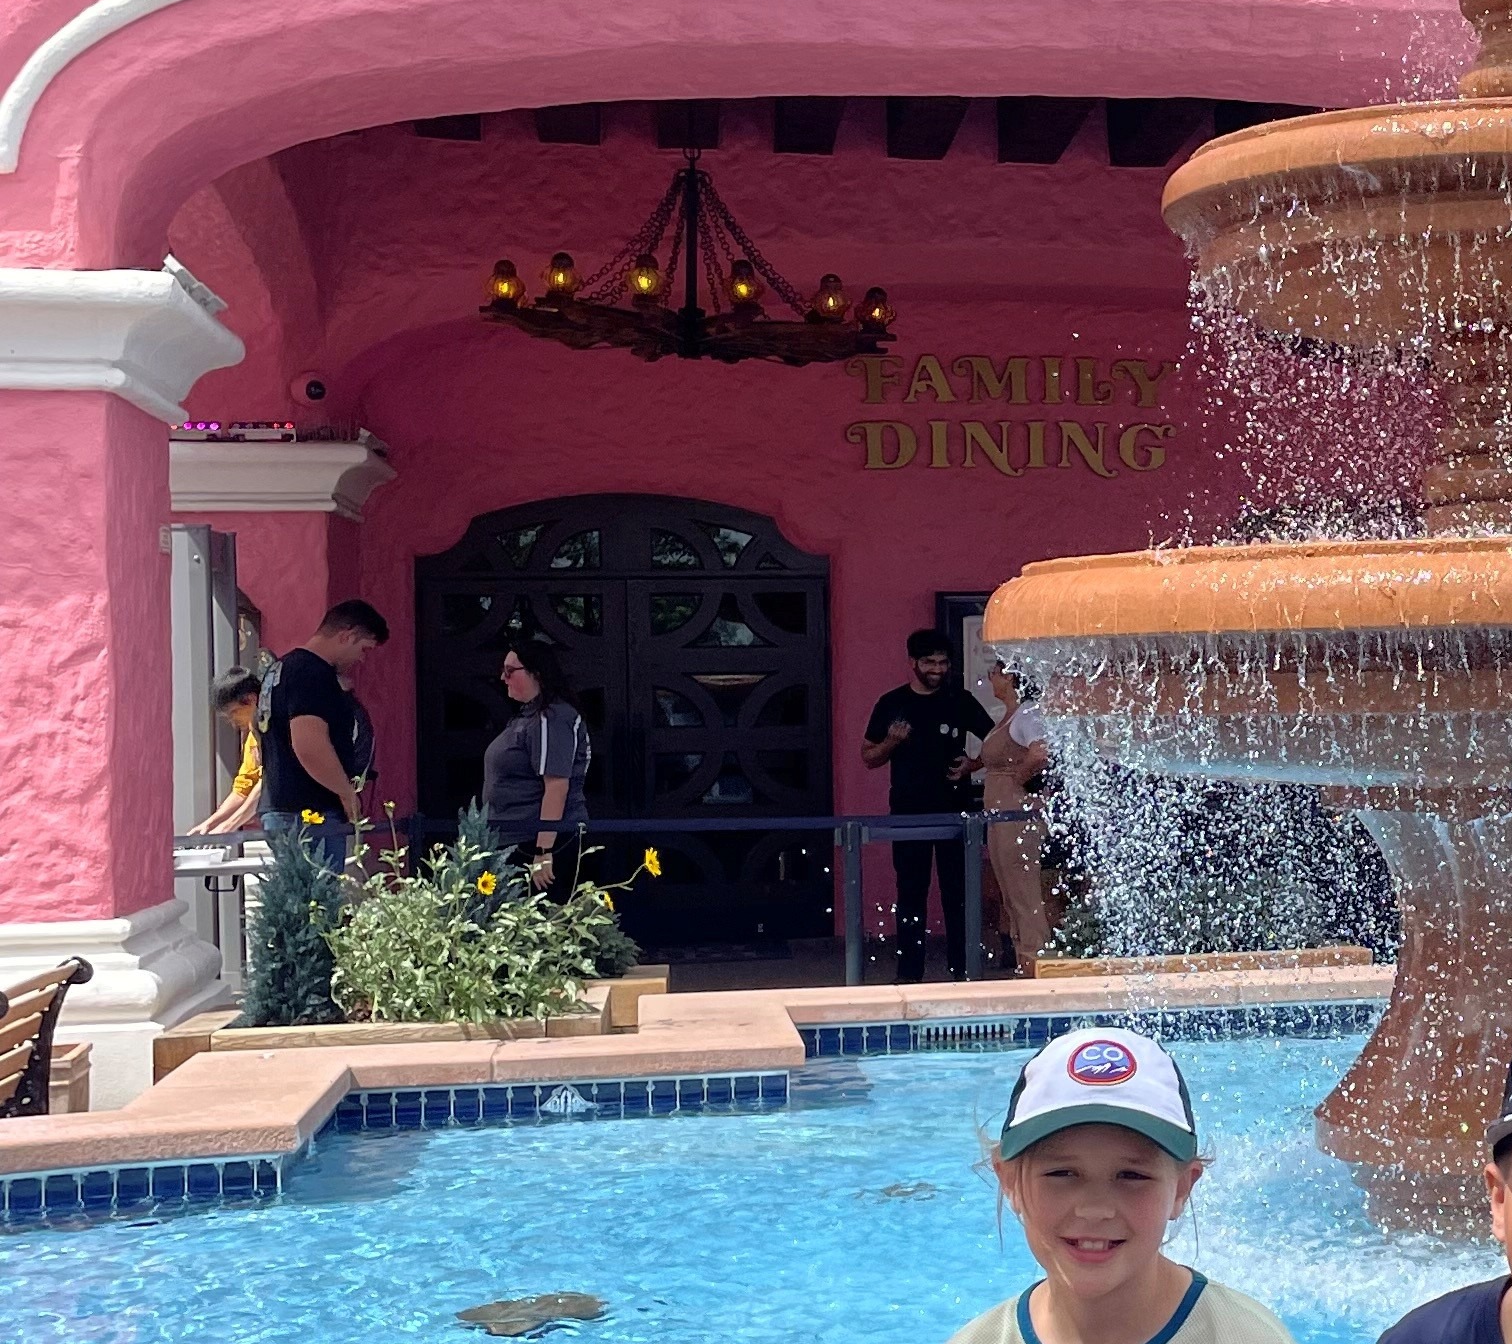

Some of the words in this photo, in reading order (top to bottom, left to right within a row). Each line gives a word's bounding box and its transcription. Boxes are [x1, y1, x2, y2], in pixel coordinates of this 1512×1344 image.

[845, 354, 1178, 408] FAMILY
[845, 418, 1178, 478] DINING
[1081, 1045, 1124, 1061] CO
